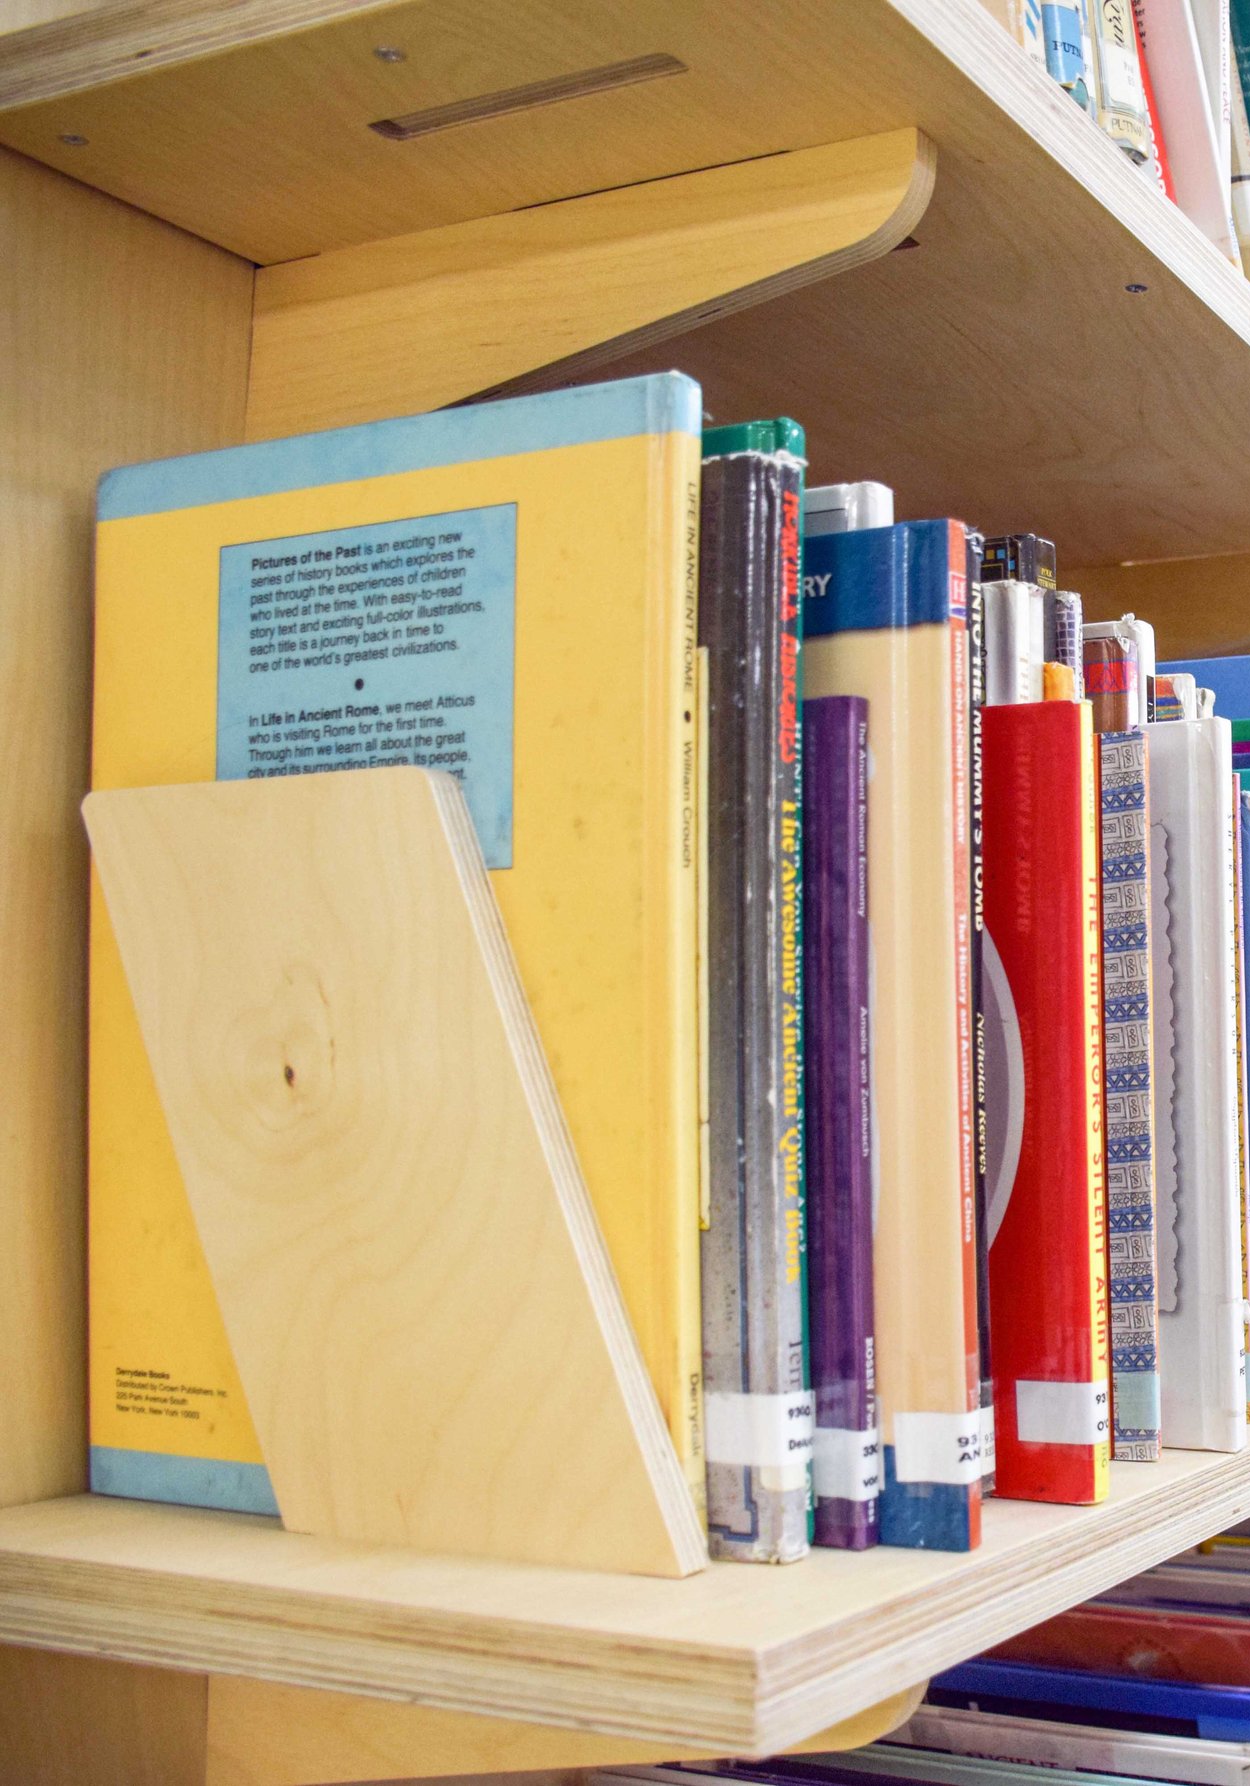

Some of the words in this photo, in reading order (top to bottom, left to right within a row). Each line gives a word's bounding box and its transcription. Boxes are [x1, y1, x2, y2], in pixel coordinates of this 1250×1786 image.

[686, 481, 696, 522] LIFE
[251, 554, 298, 570] Pictures
[300, 550, 312, 564] of
[314, 548, 332, 562] the
[335, 544, 362, 559] Past
[364, 543, 373, 555] is
[376, 542, 389, 554] an
[392, 536, 435, 552] exciting
[438, 533, 463, 546] new
[687, 526, 695, 545] IN
[250, 573, 282, 587] series
[284, 570, 295, 583] of
[298, 567, 333, 581] history
[335, 562, 368, 576] books
[371, 556, 403, 572] which
[406, 552, 454, 568] explores
[457, 548, 475, 561] the
[250, 590, 273, 607] past
[275, 584, 316, 601] through
[318, 583, 335, 596] the
[338, 576, 404, 595] experiences
[407, 572, 418, 585] of
[421, 568, 466, 583] children
[250, 607, 272, 620] who
[274, 603, 299, 618] lived
[301, 602, 312, 615] at
[314, 600, 331, 613] the
[363, 593, 388, 608] With
[685, 548, 696, 637] ANCIENT
[249, 624, 275, 637] story
[278, 620, 297, 634] text
[300, 618, 320, 632] and
[322, 614, 364, 629] exciting
[249, 641, 275, 655] each
[278, 639, 296, 652] title
[299, 638, 308, 650] is
[311, 638, 318, 649] a
[320, 634, 360, 650] journey
[363, 629, 389, 643] back
[392, 628, 402, 640] in
[406, 626, 430, 639] time
[433, 623, 444, 636] to
[249, 661, 269, 672] one
[271, 657, 282, 670] of
[284, 656, 301, 669] the
[344, 646, 388, 665] greatest
[683, 639, 694, 692] ROME
[249, 714, 259, 726] In
[261, 712, 282, 725] Life
[285, 711, 295, 723] in
[298, 706, 342, 722] Ancient
[386, 703, 402, 714] we
[405, 698, 433, 712] meet
[436, 696, 475, 710] Atticus
[248, 731, 270, 744] who
[272, 730, 281, 742] is
[284, 727, 320, 741] visiting
[323, 725, 356, 737] Rome
[358, 722, 373, 734] for
[376, 720, 393, 733] the
[396, 718, 416, 731] first
[248, 745, 292, 761] Through
[294, 744, 314, 757] him
[316, 744, 333, 756] we
[334, 742, 362, 754] learn
[365, 739, 378, 752] all
[380, 736, 412, 751] about
[414, 735, 432, 748] the
[435, 732, 465, 749] great
[859, 722, 867, 745] The
[684, 741, 693, 803] William
[859, 749, 867, 800] Ancient
[683, 806, 692, 868] Crouch
[859, 805, 867, 854] Roman
[857, 857, 867, 918] Economy
[958, 913, 967, 941] The
[958, 947, 967, 1004] History
[960, 1009, 968, 1037] and
[960, 1041, 970, 1112] Activities
[962, 1115, 970, 1131] of
[963, 1134, 971, 1192] Ancient
[965, 1197, 973, 1243] China
